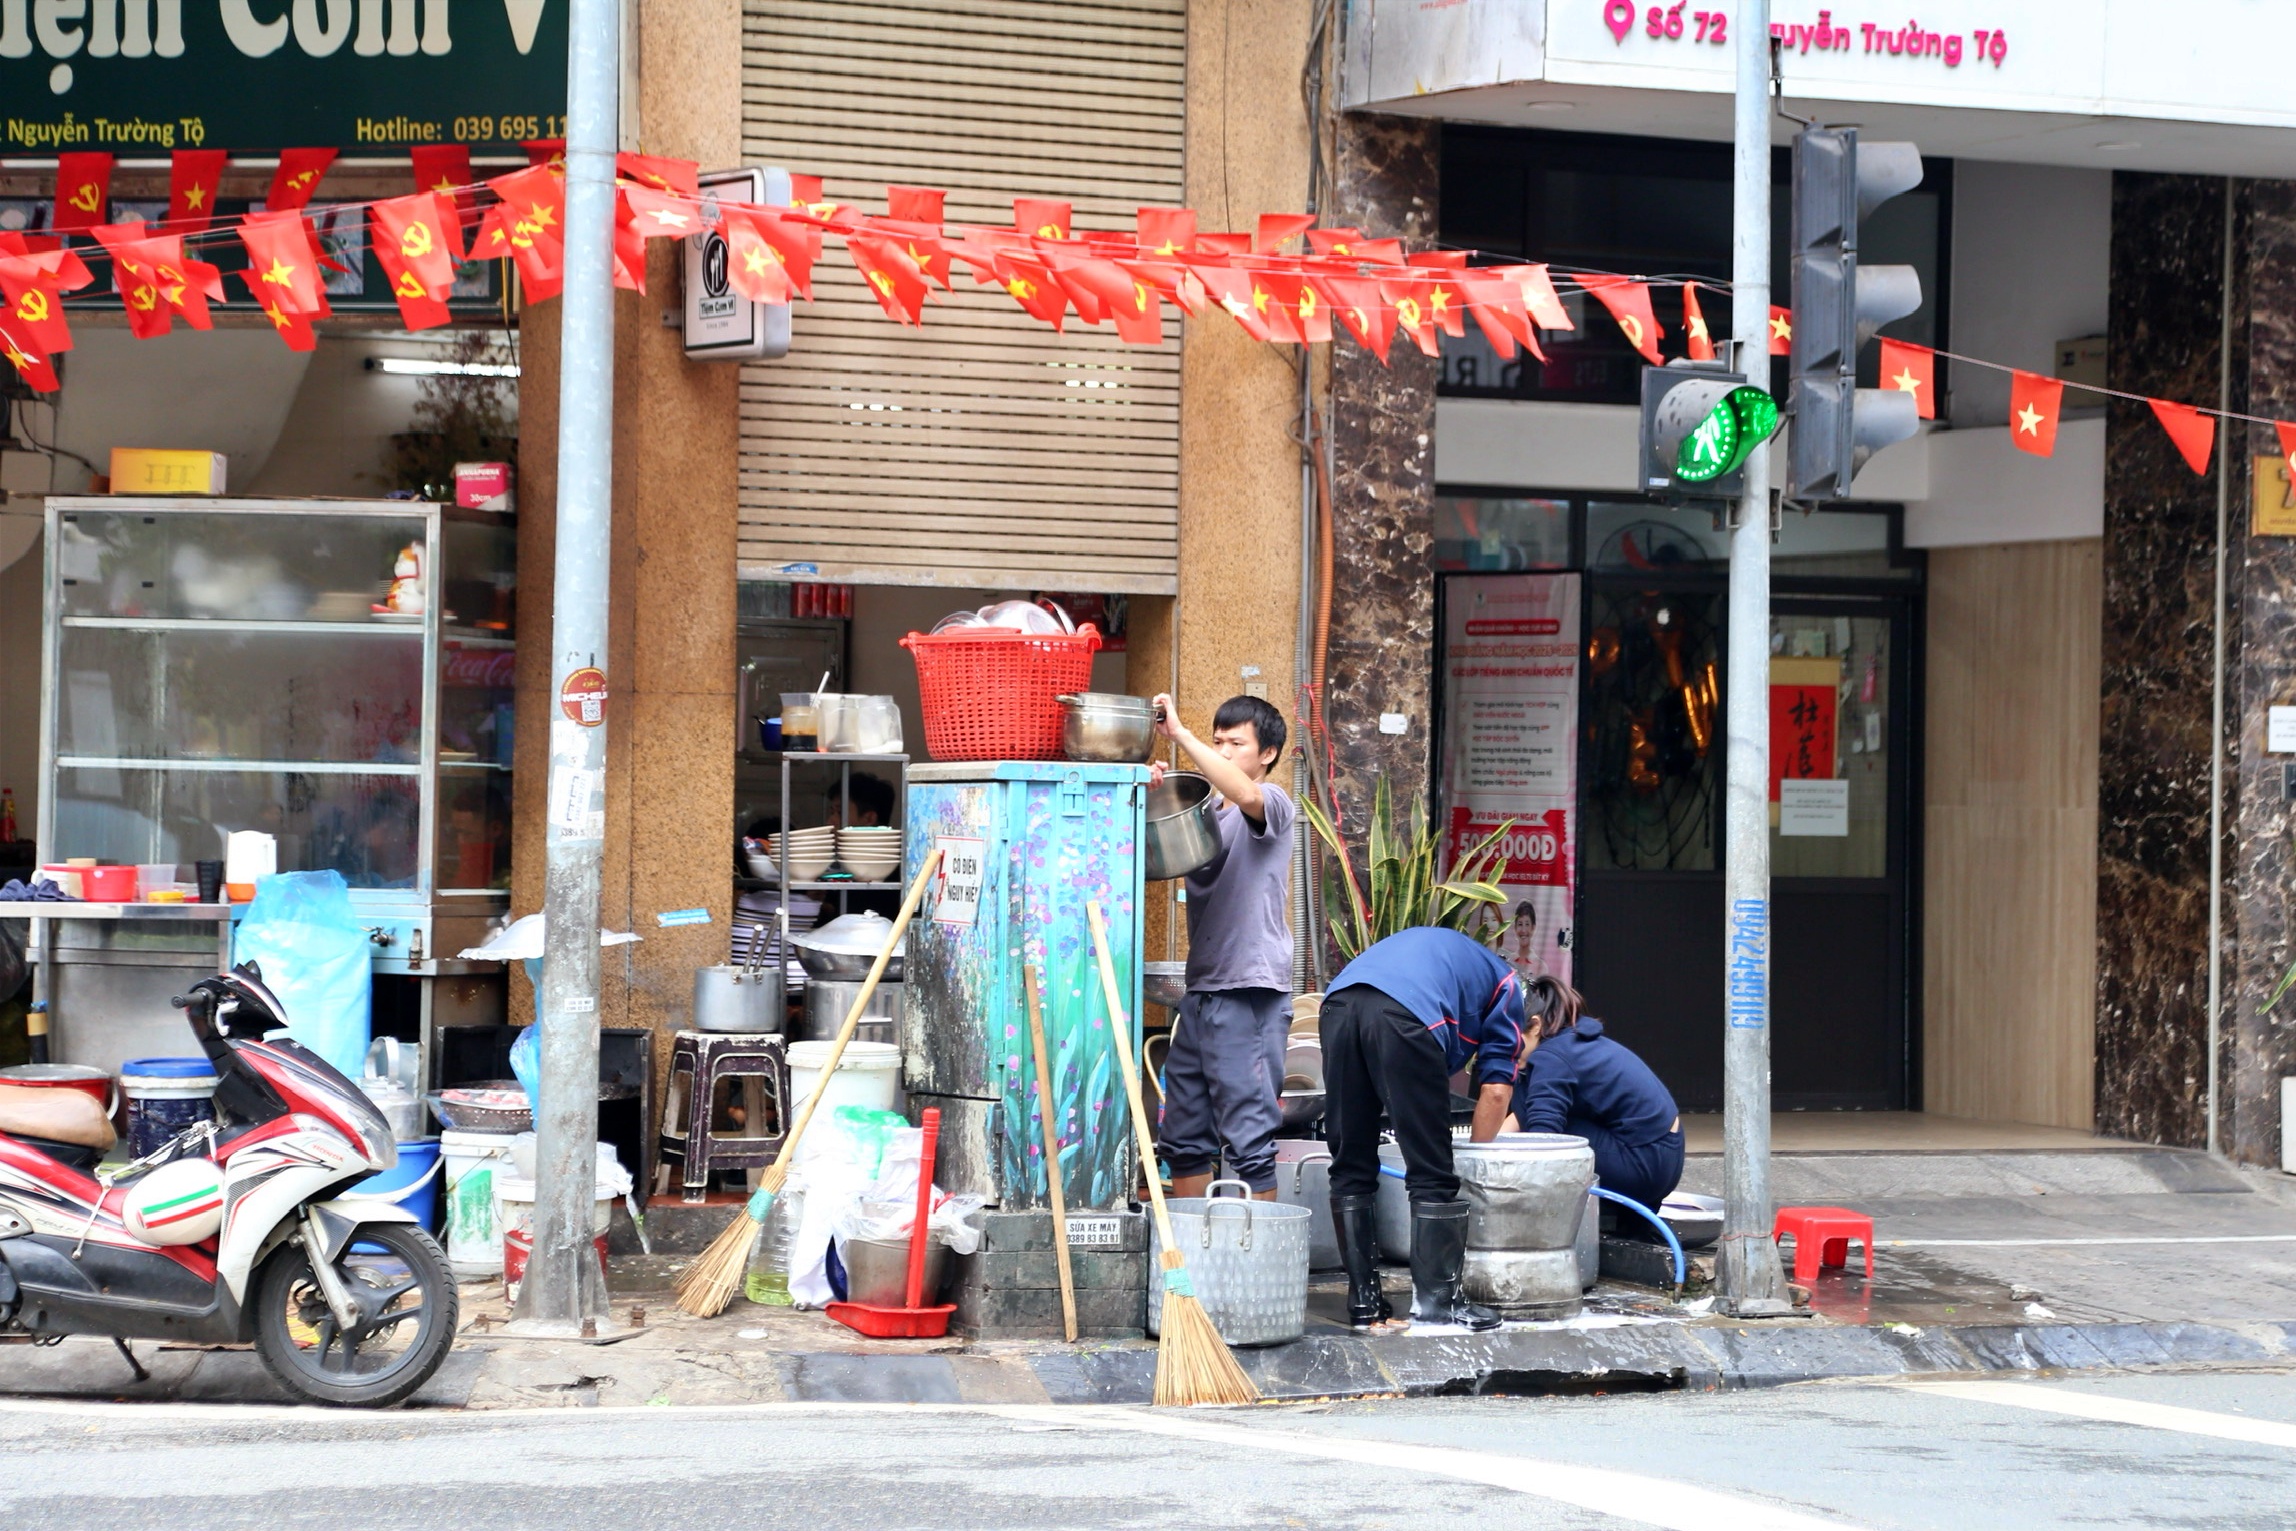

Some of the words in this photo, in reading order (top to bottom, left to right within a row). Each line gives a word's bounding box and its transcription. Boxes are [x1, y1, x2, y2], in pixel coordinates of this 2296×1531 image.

[1646, 0, 1685, 38] Số
[1694, 12, 1727, 43] 72
[1861, 19, 1962, 66] Trường
[1974, 29, 2007, 68] Tộ
[8, 113, 88, 146] Nguyễn
[95, 117, 174, 146] Trường
[179, 117, 205, 146] Tộ
[356, 117, 442, 141] Hotline:
[454, 117, 493, 140] 039
[500, 116, 538, 139] 695
[1088, 1223, 1097, 1232] XE
[1100, 1221, 1116, 1232] MÁY
